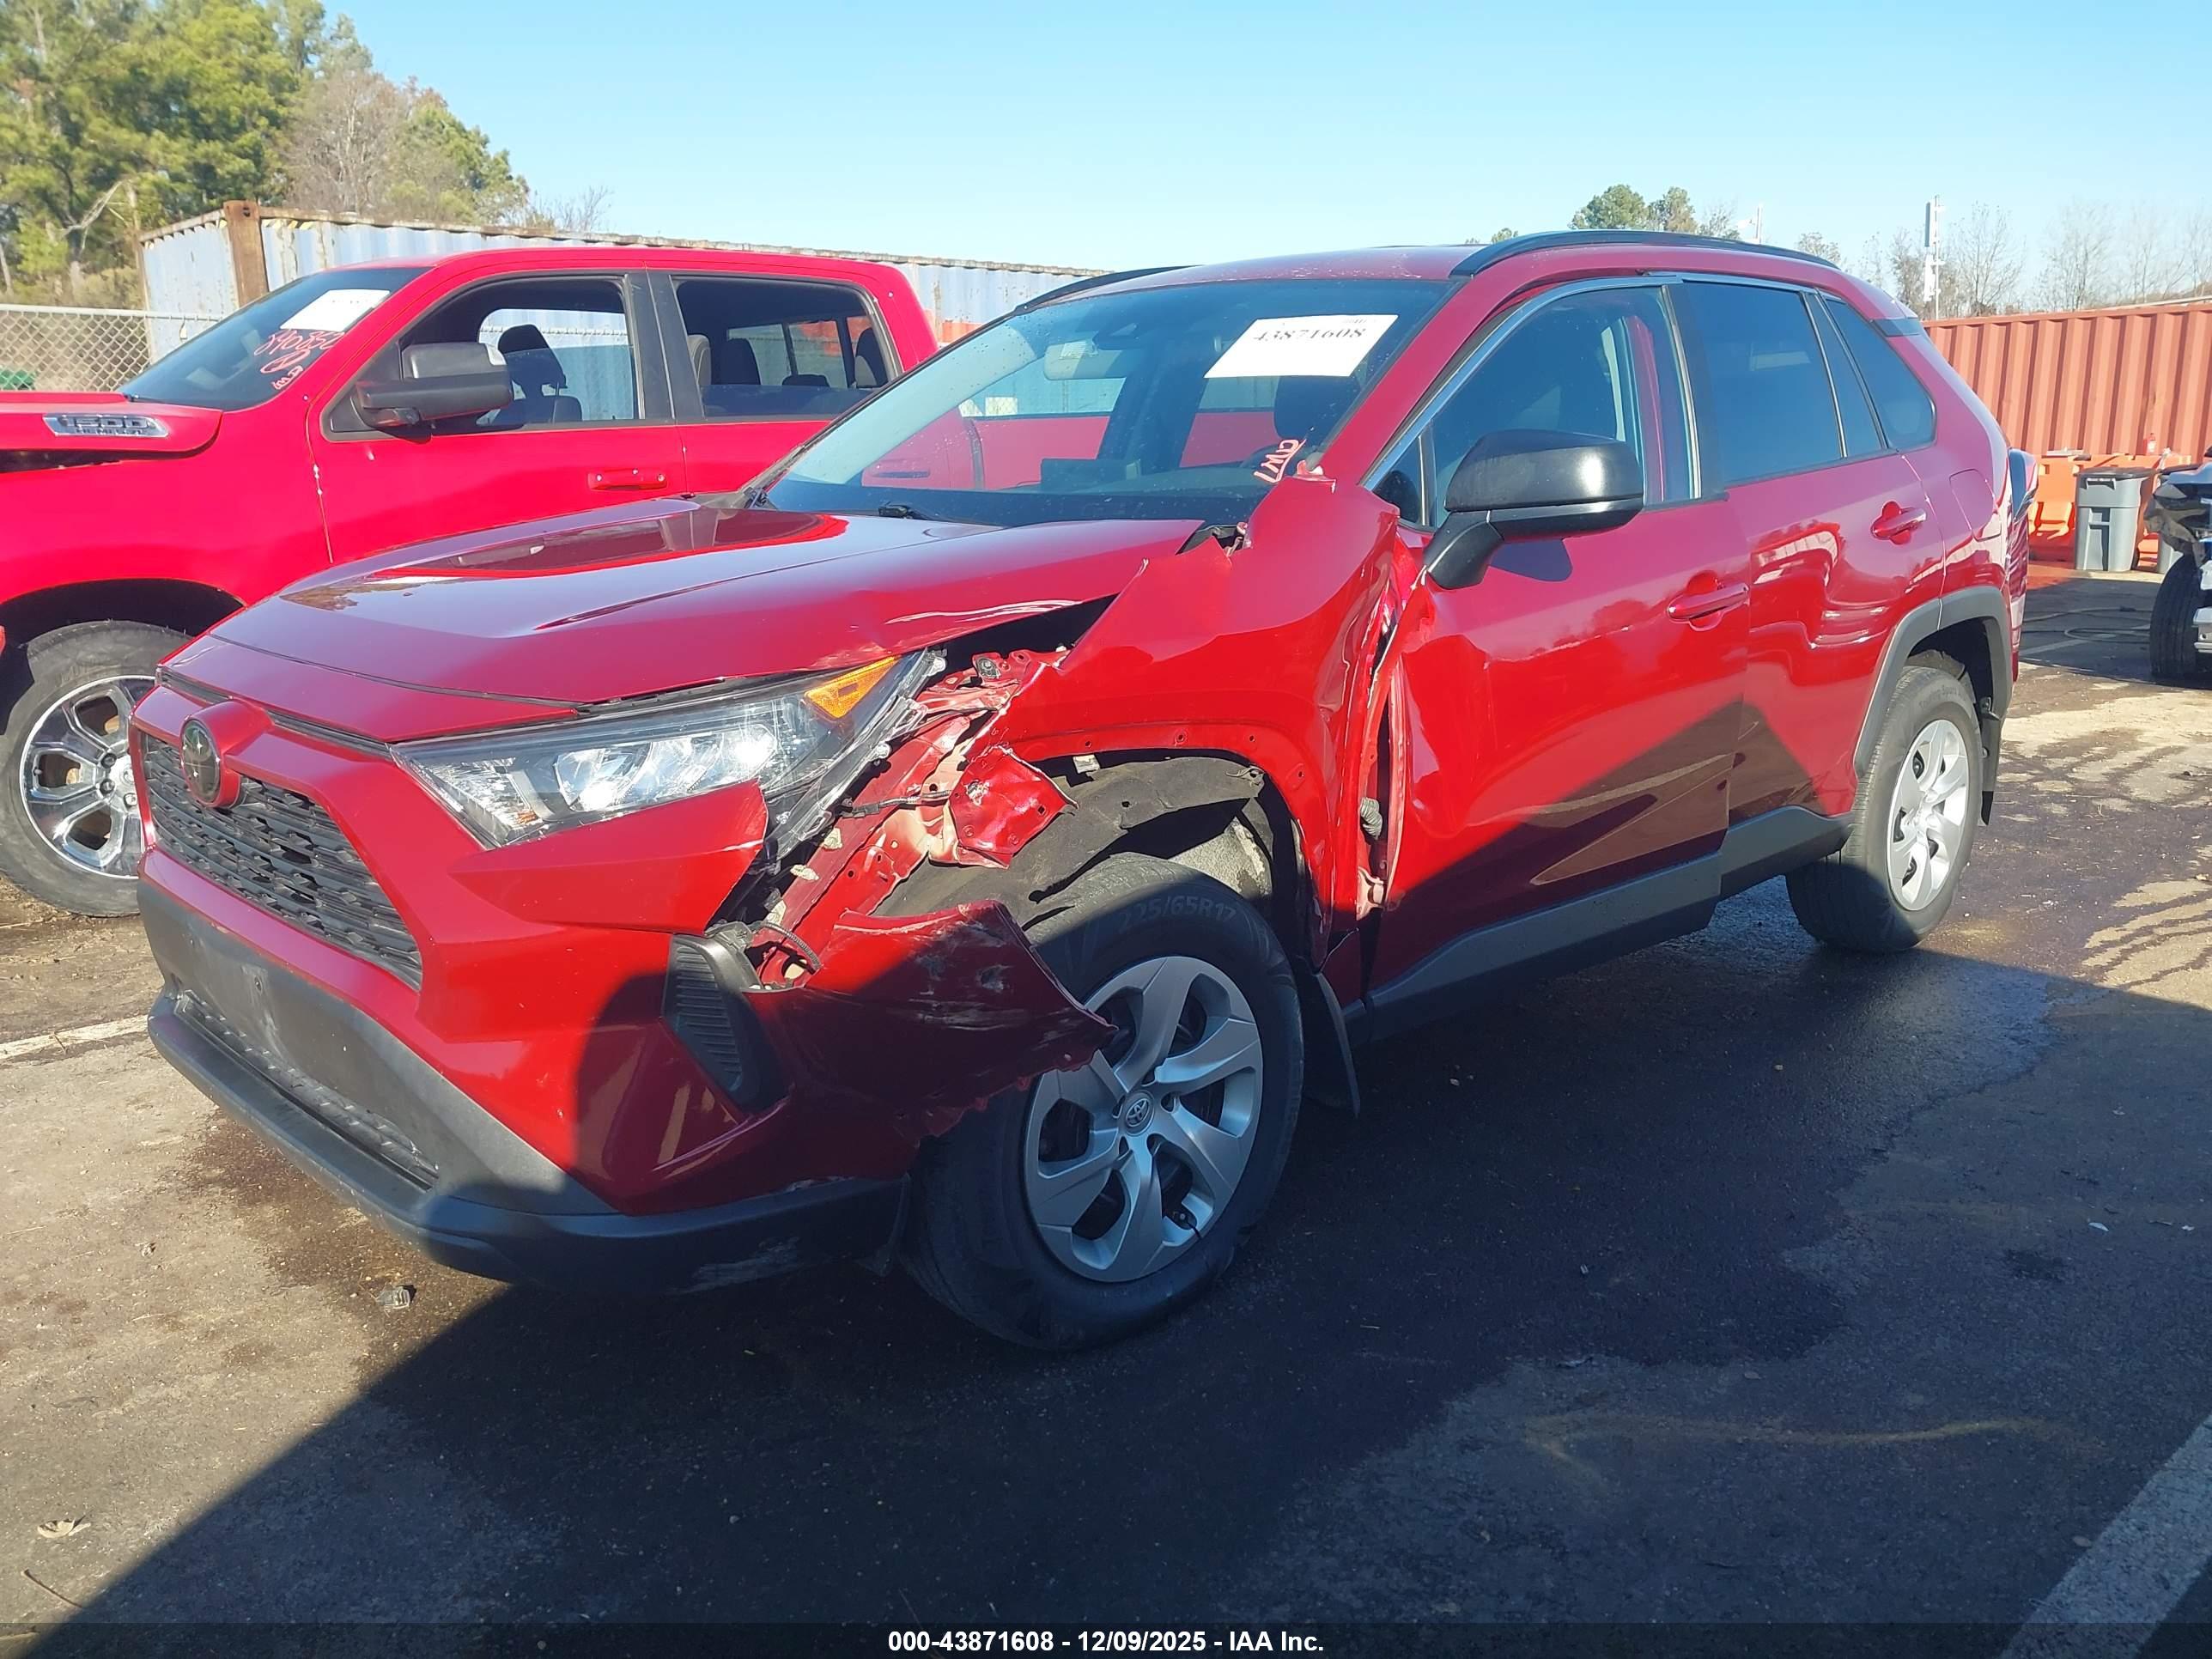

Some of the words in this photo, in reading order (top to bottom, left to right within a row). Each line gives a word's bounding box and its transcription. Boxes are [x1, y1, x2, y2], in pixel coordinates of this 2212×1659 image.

[1253, 328, 1366, 342] 43871608
[58, 414, 149, 428] 1500
[1118, 896, 1237, 933] 225/65R17
